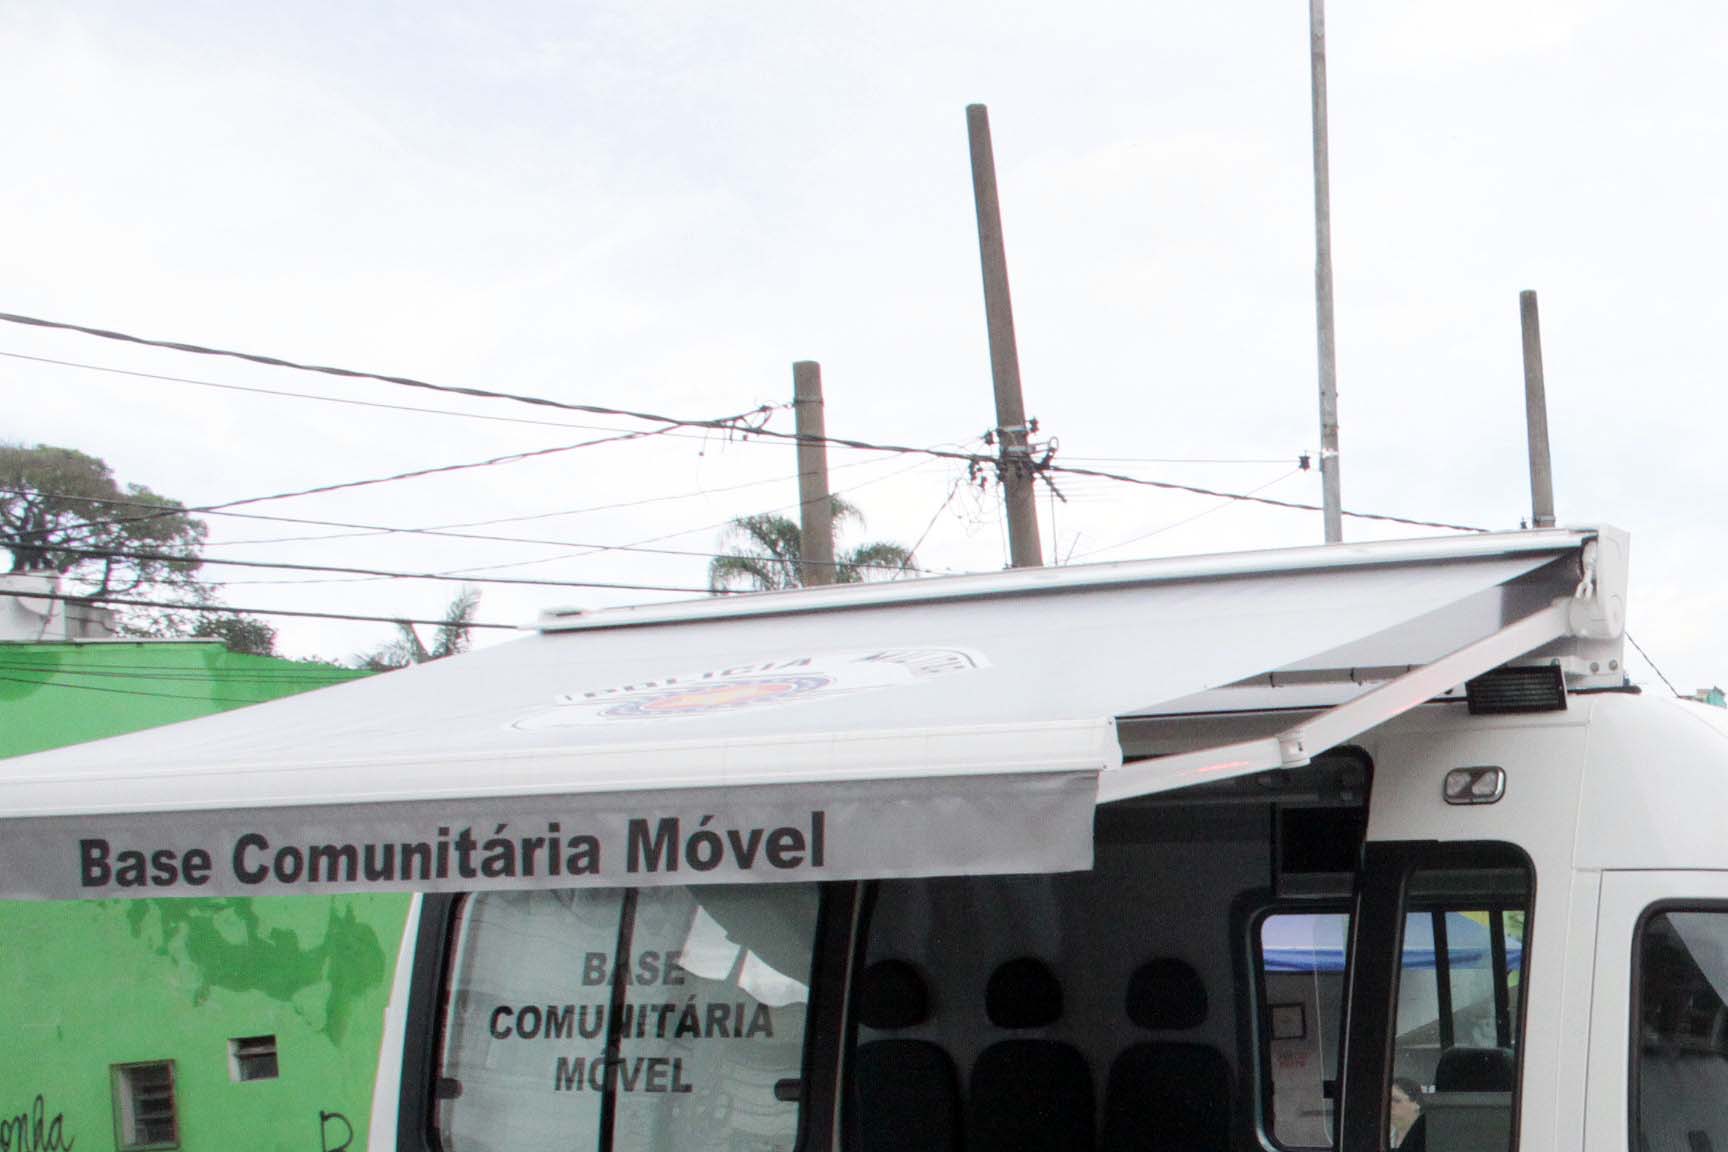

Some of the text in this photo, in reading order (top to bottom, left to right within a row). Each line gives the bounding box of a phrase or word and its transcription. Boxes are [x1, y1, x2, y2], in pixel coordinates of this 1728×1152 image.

[79, 810, 825, 887] Base Comunitária Móvel
[489, 994, 774, 1040] COMUNITÁRIA
[554, 1050, 694, 1093] MÓVEL
